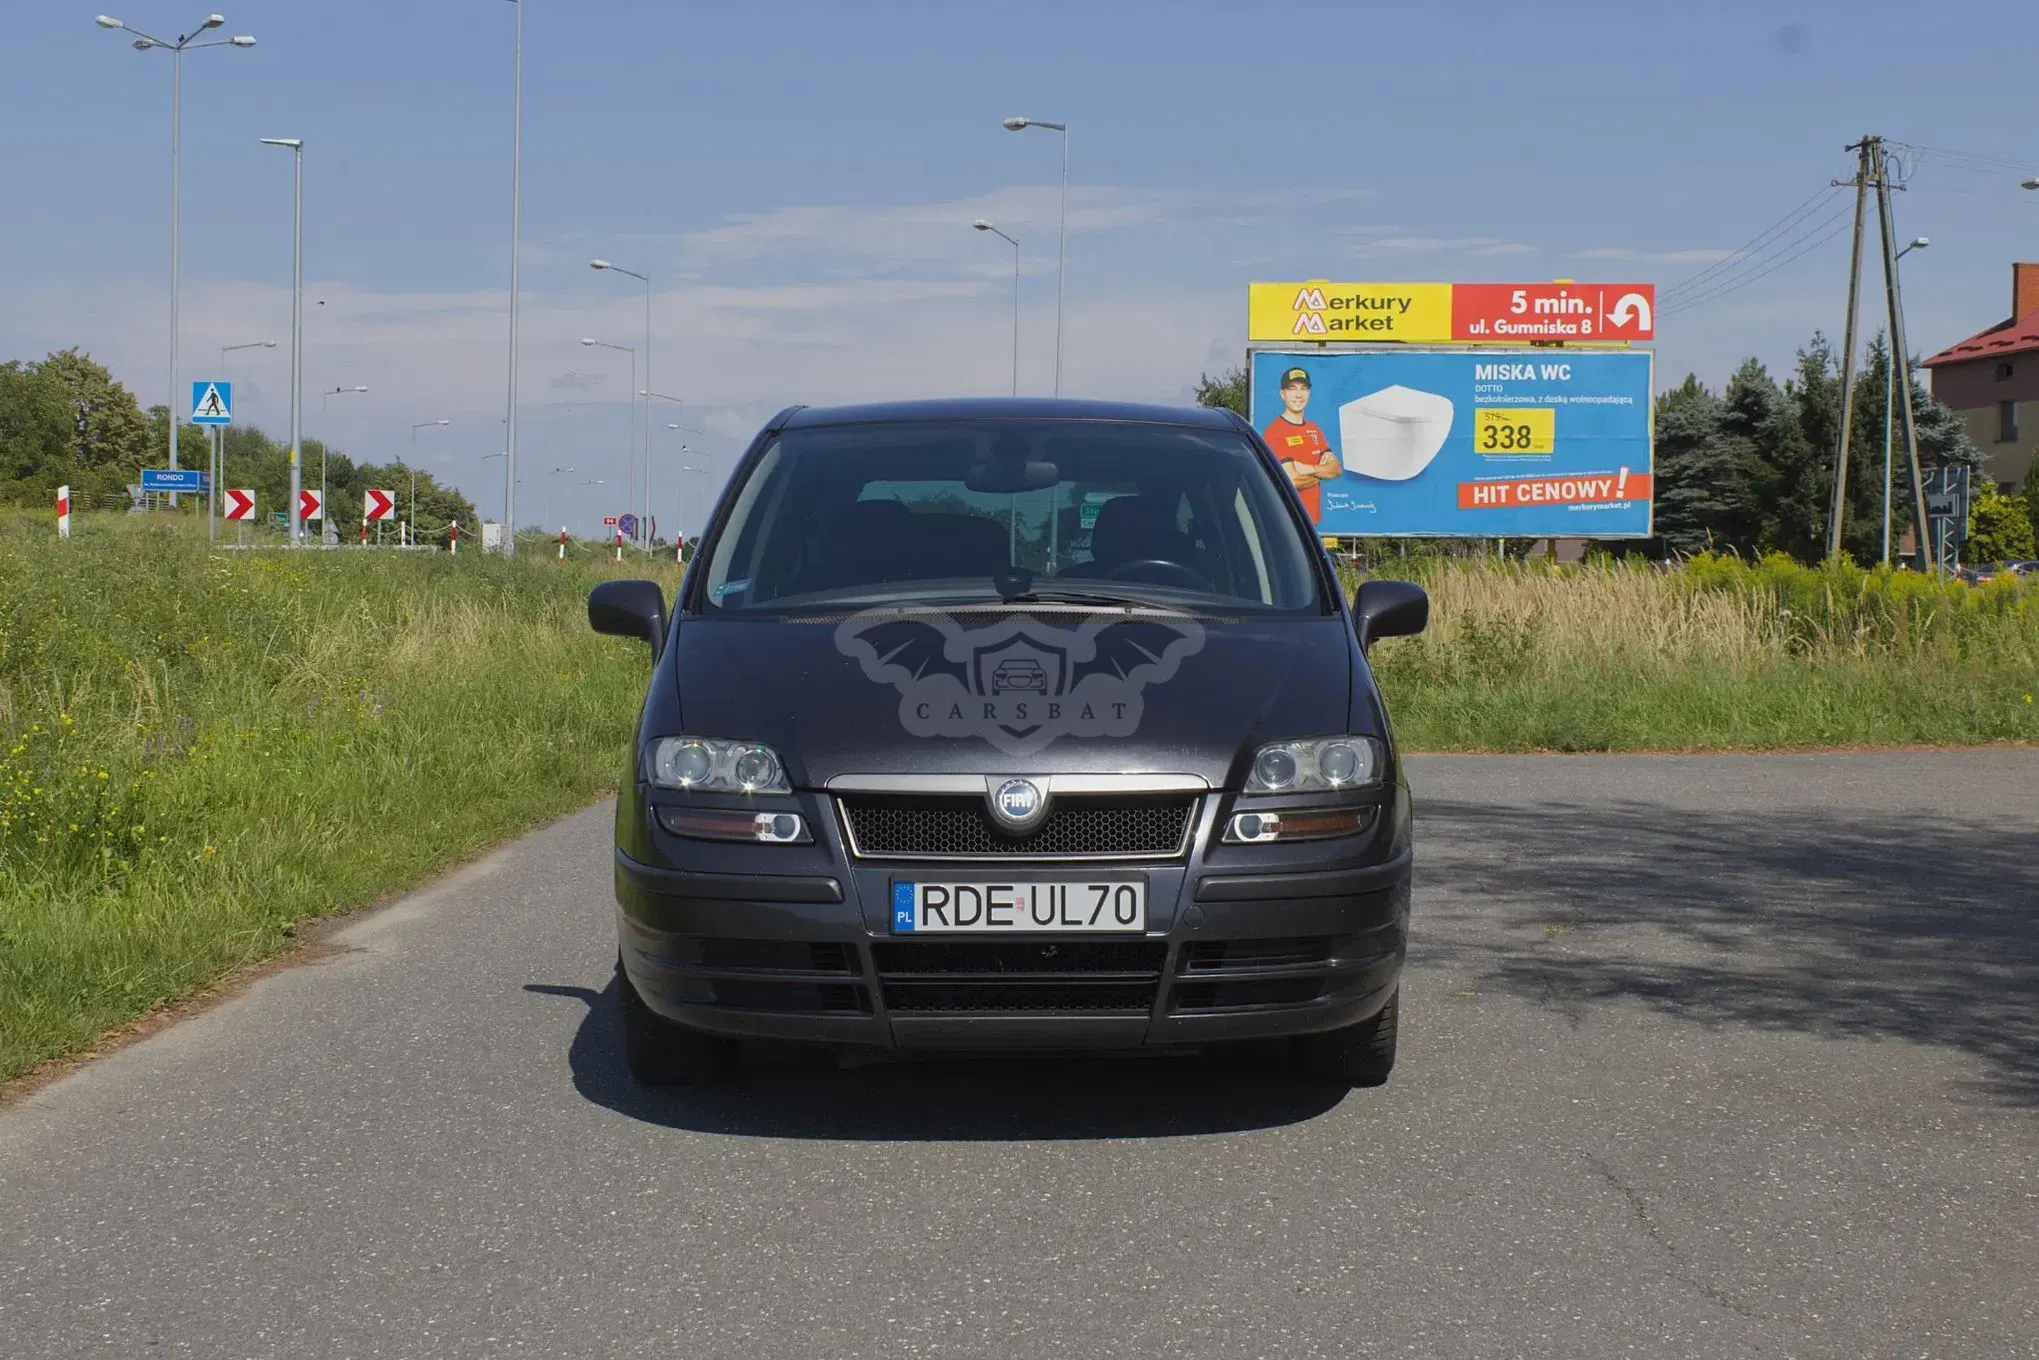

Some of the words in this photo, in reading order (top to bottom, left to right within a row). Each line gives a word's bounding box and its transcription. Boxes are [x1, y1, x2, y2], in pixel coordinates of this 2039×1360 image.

[1292, 288, 1412, 314] Merkury
[1510, 290, 1528, 314] 5
[1534, 290, 1593, 314] min.
[1292, 312, 1394, 335] Market
[1469, 319, 1490, 334] ul.
[1494, 319, 1577, 334] Gumniska
[1581, 319, 1592, 334] 8
[1475, 364, 1536, 381] MISKA
[1540, 364, 1571, 381] WC
[1474, 384, 1504, 393] DOTTO
[1483, 425, 1531, 449] 338
[156, 473, 184, 481] RONDO
[1473, 485, 1510, 504] HIT
[1568, 501, 1632, 513] merkurymarket.pl
[922, 885, 1014, 926] RDE
[1031, 885, 1137, 926] UL70
[897, 911, 912, 923] PL
